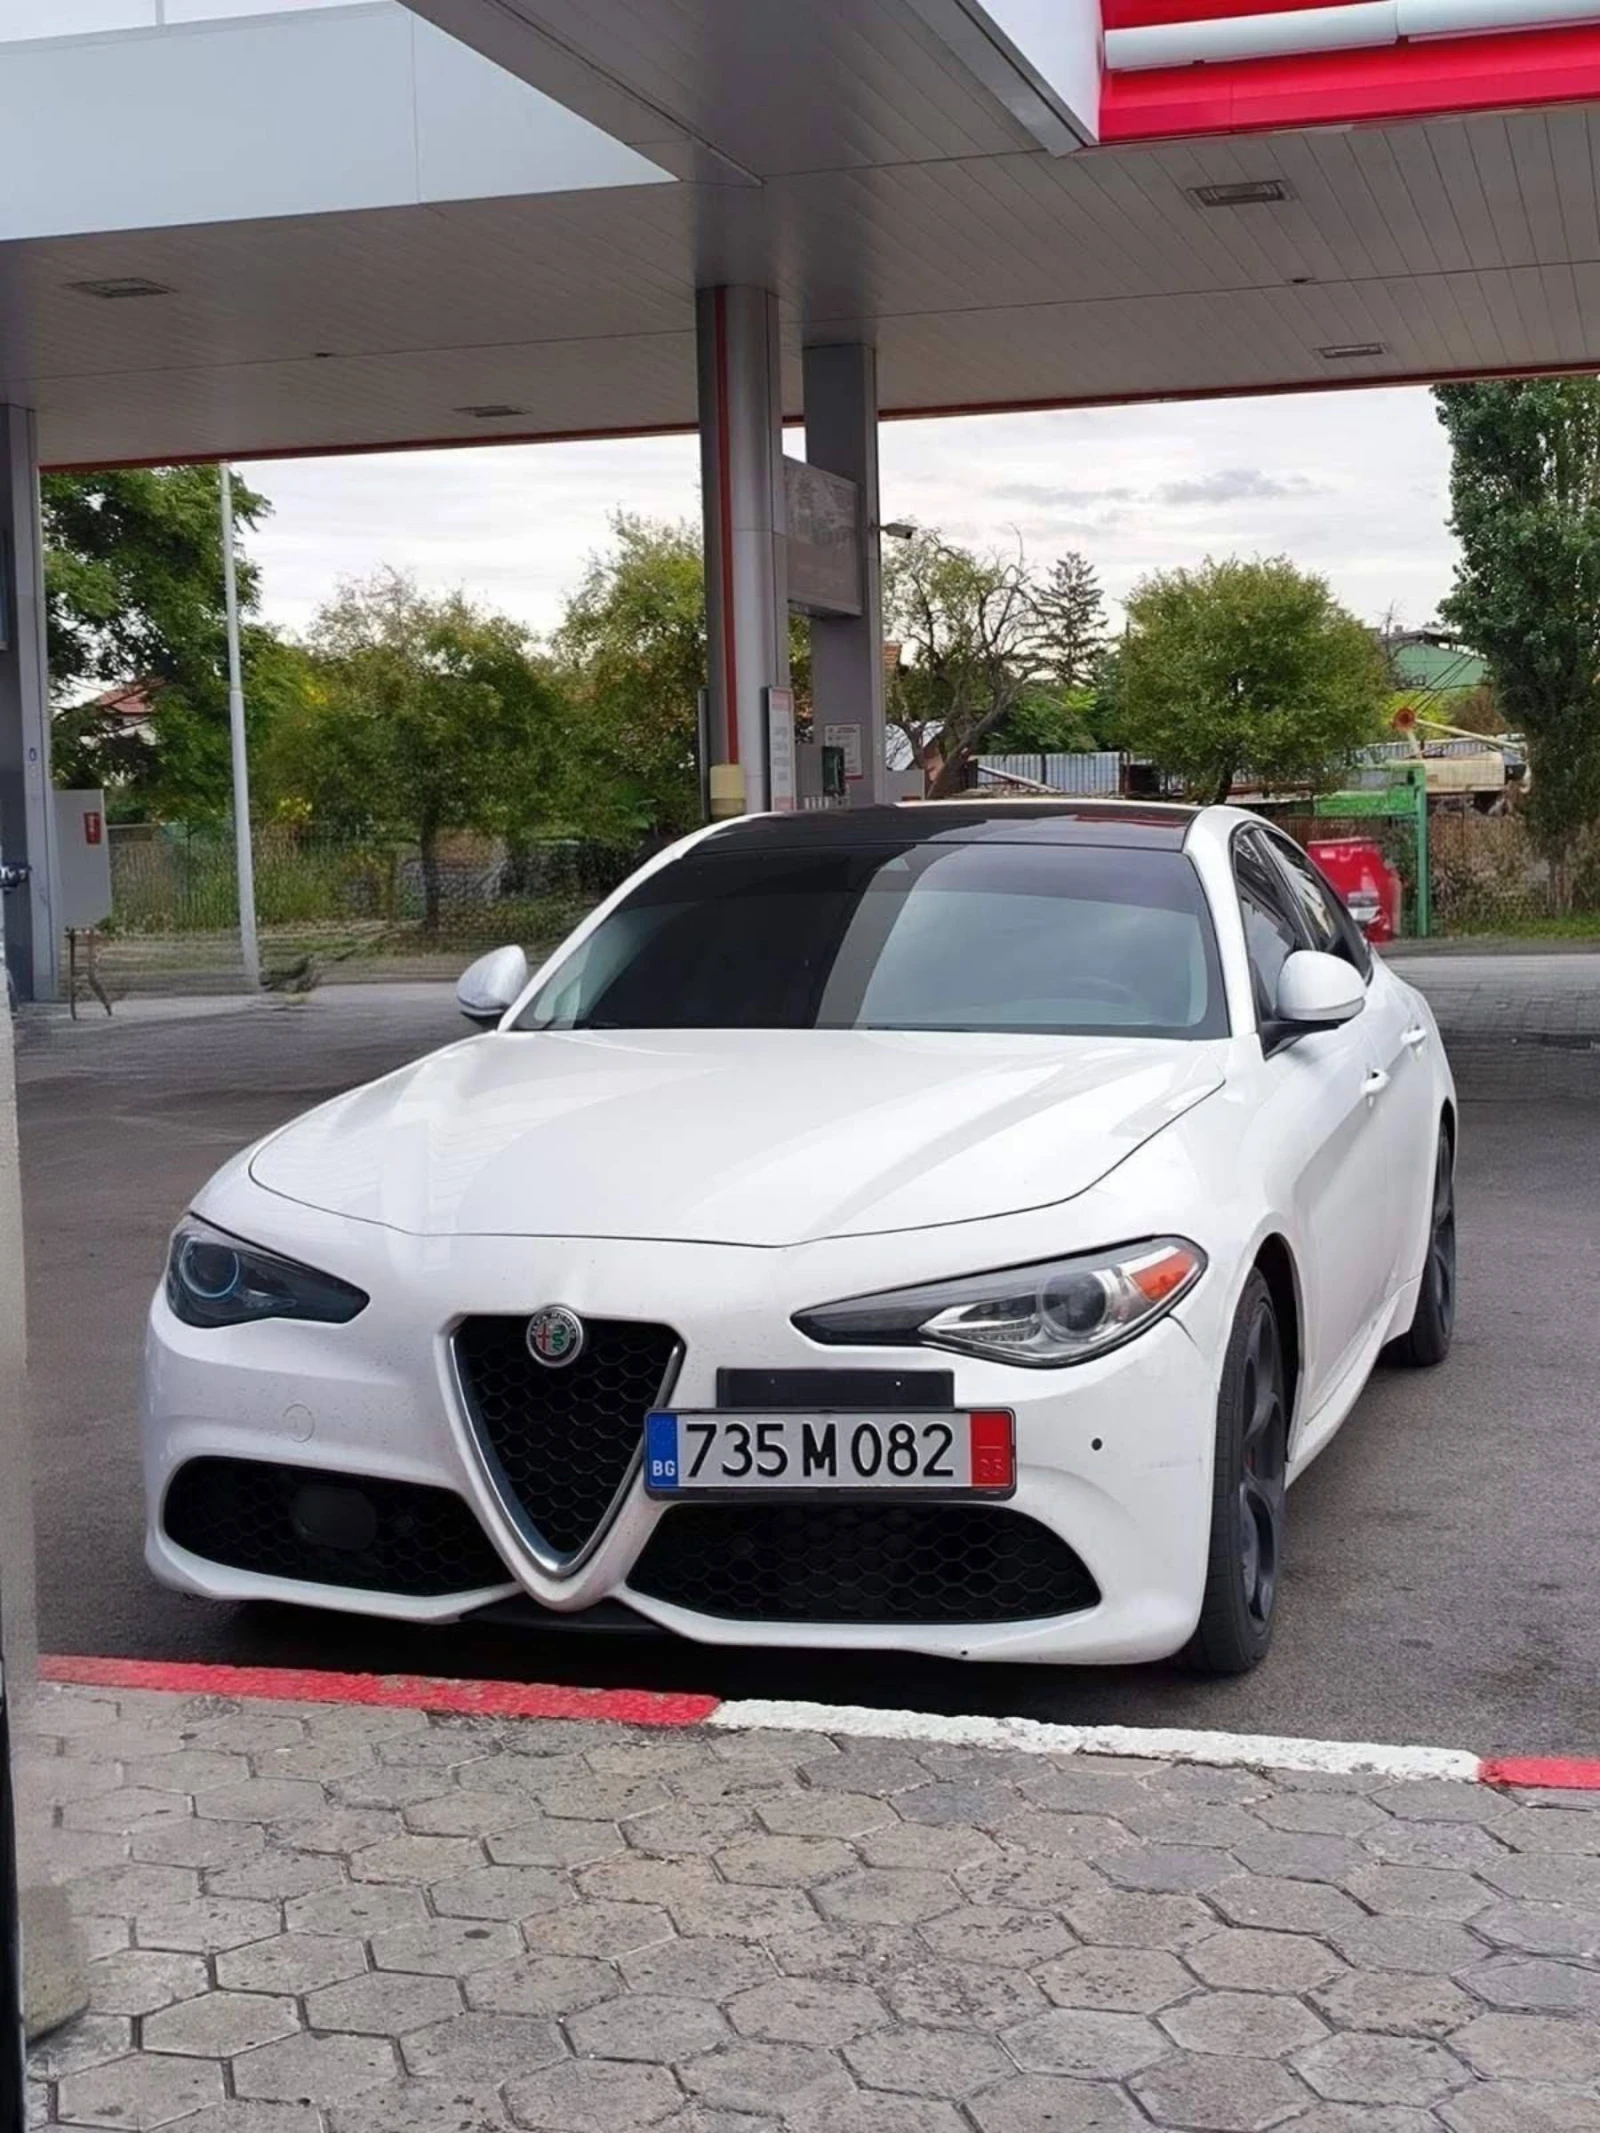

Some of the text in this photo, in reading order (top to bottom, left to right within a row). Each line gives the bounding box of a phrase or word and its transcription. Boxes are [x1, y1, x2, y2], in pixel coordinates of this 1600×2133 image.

[686, 1424, 953, 1477] 735 M 082
[652, 1460, 676, 1477] BG
